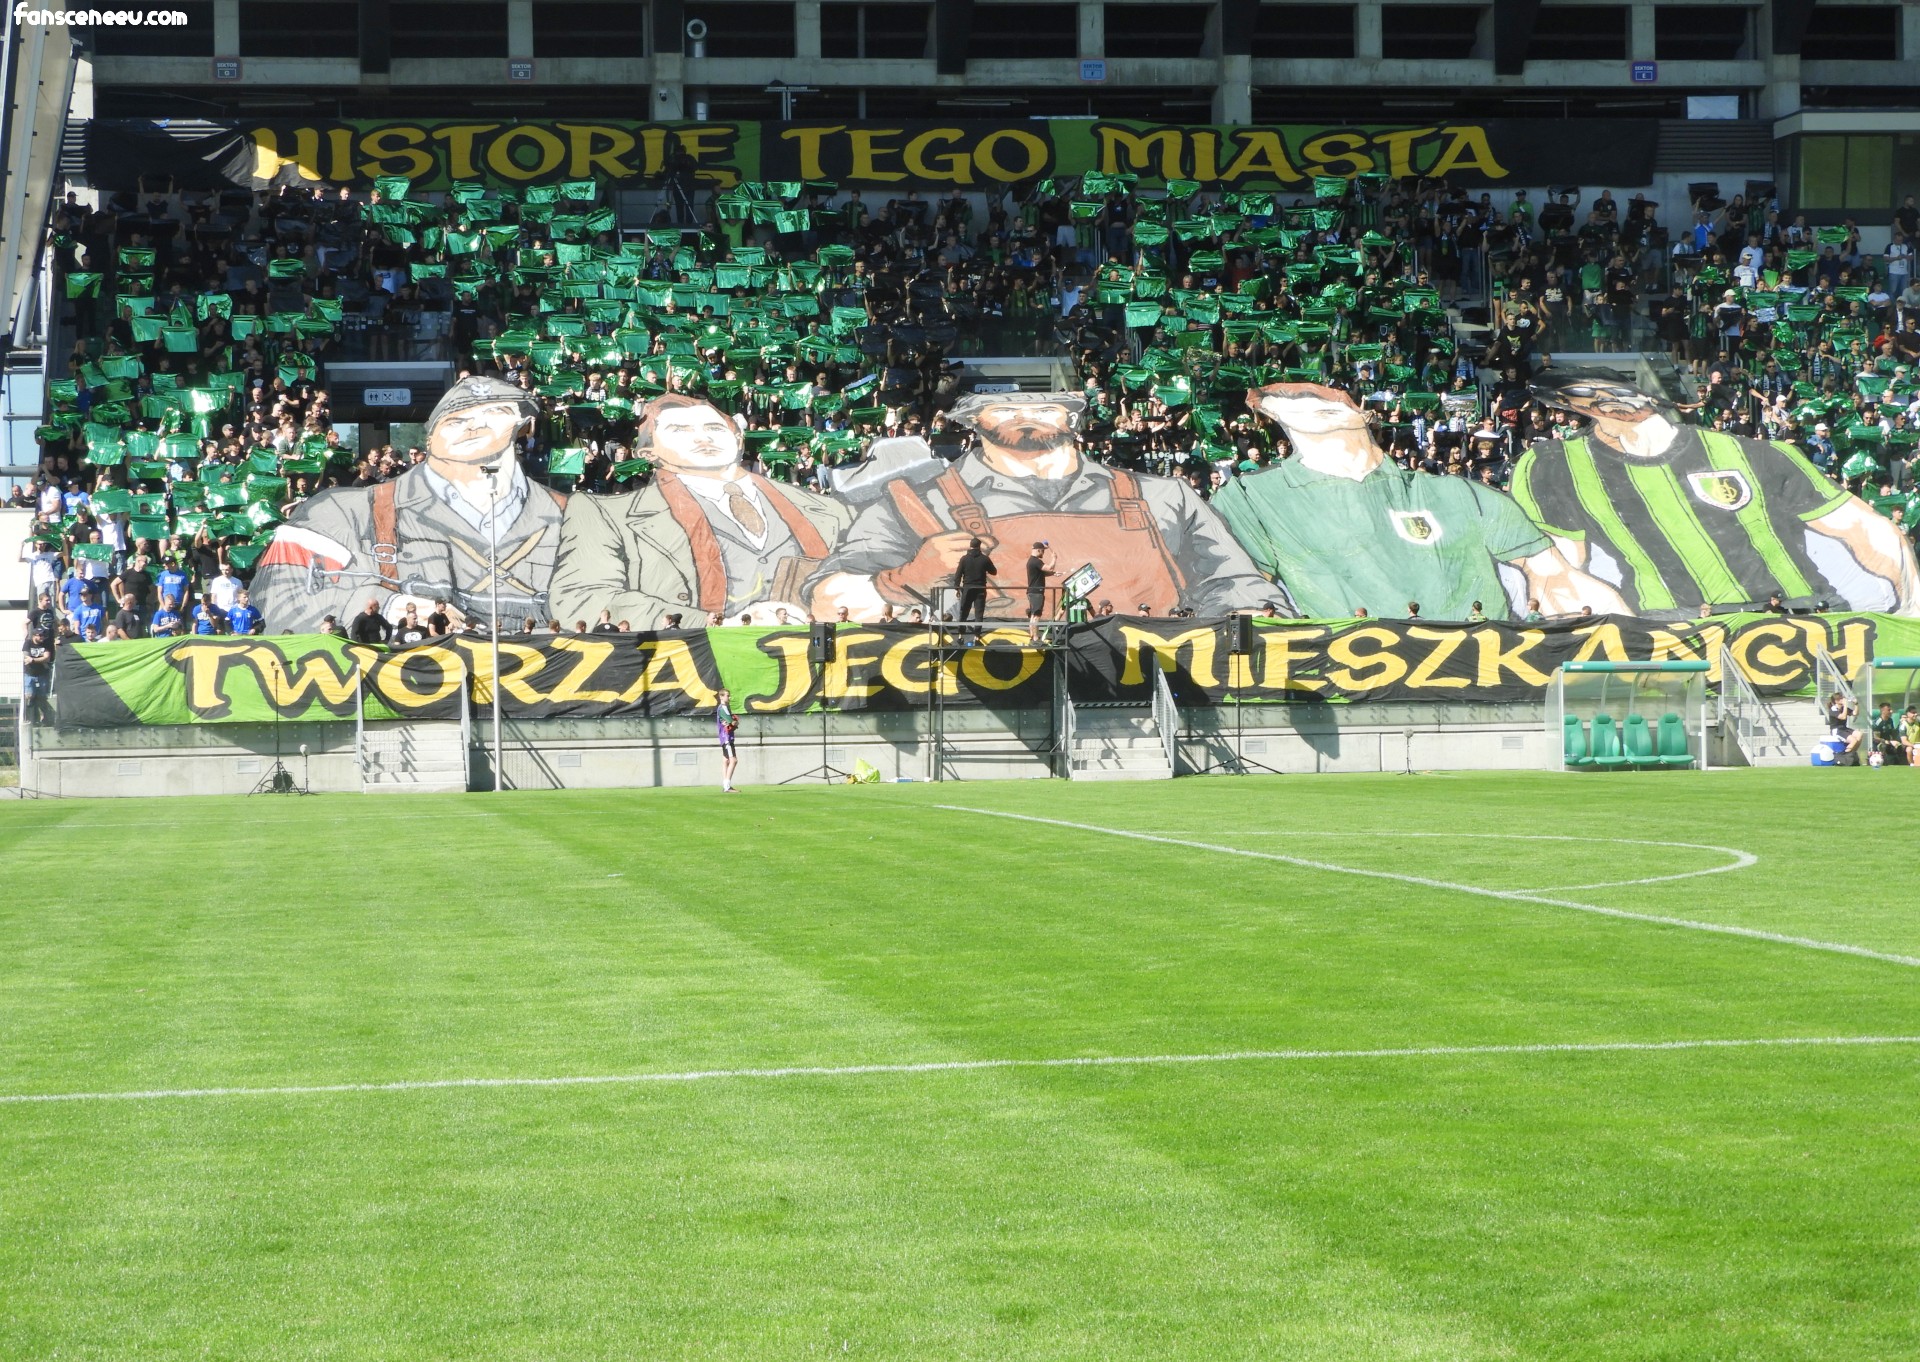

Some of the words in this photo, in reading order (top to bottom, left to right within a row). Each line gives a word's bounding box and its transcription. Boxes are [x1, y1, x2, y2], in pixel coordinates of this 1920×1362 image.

[781, 125, 1048, 184] TEGO
[1097, 126, 1509, 183] MIASTA
[751, 628, 1045, 710] JEGO
